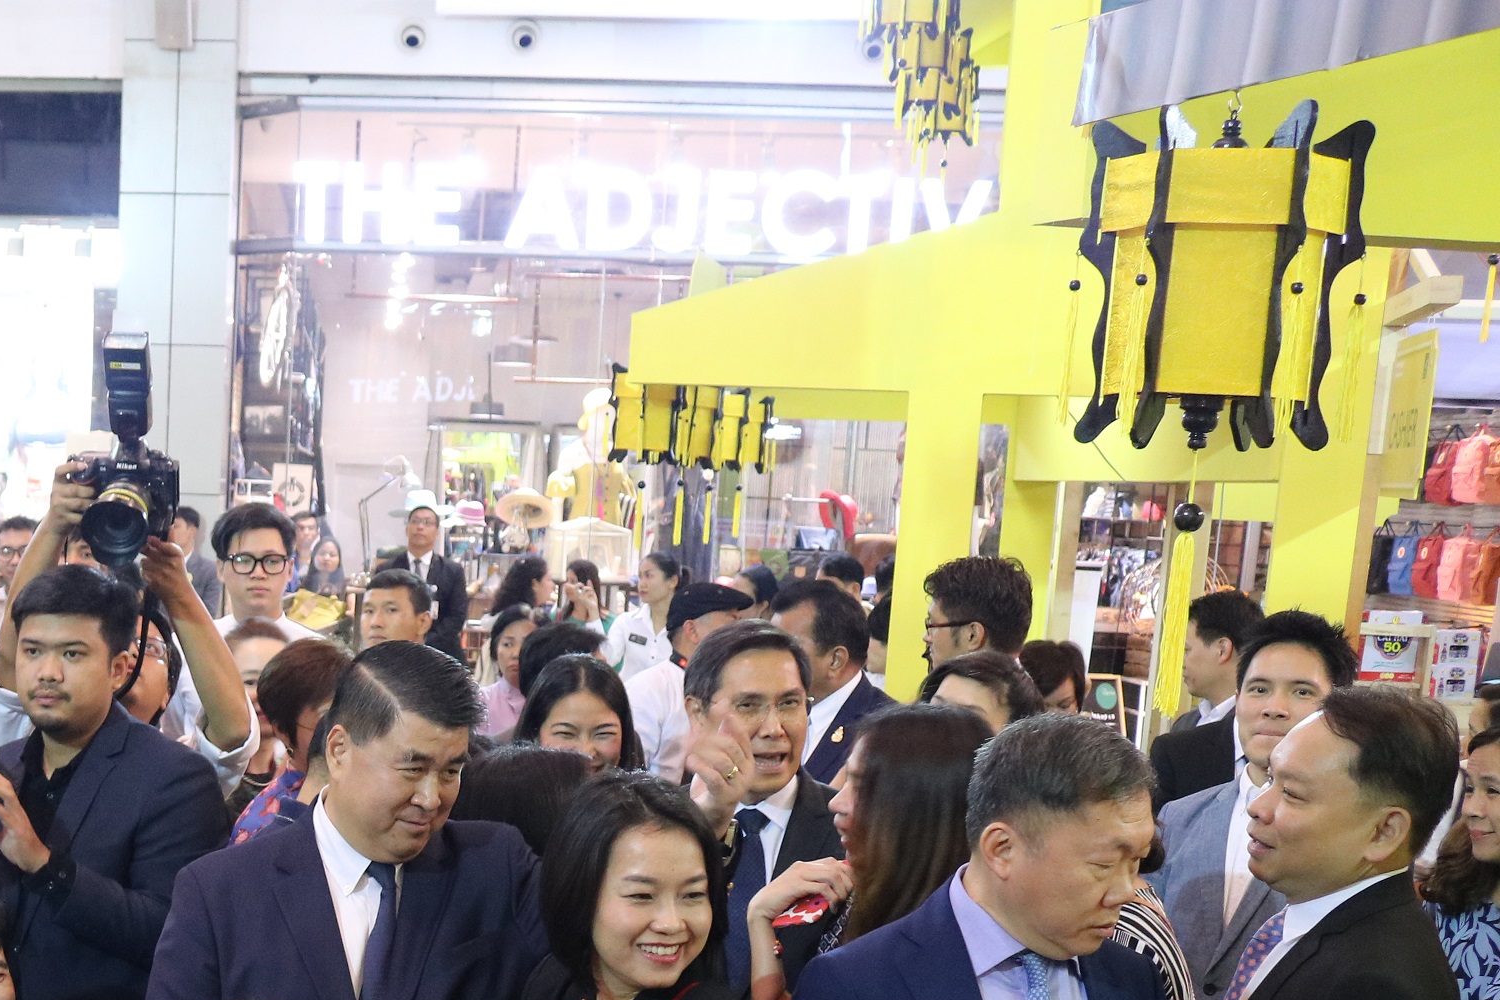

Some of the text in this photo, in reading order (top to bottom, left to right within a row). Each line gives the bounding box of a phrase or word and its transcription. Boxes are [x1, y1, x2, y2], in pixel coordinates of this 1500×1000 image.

[293, 160, 463, 247] THE
[116, 462, 138, 470] Nikon
[1383, 641, 1402, 653] 50
